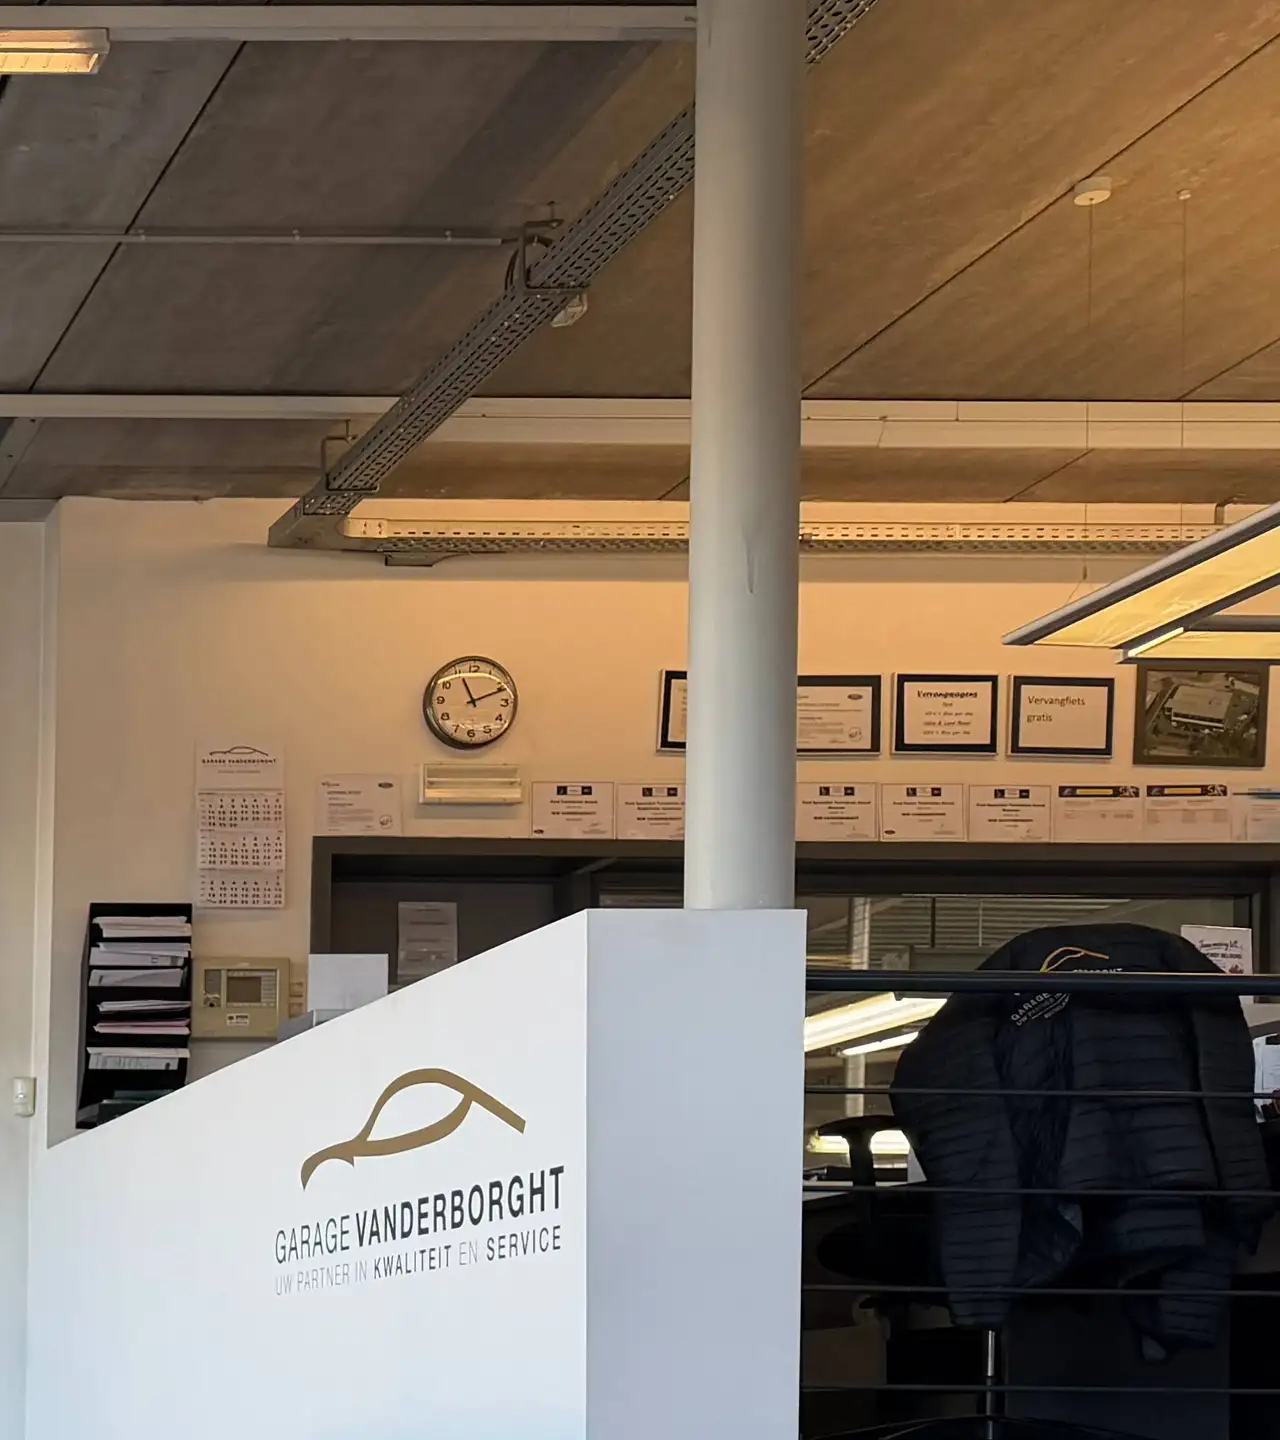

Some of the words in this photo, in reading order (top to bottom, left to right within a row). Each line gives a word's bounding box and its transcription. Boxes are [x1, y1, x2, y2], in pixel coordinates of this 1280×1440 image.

[442, 680, 451, 690] 10
[436, 695, 445, 705] 9
[500, 698, 509, 708] 3
[1027, 695, 1086, 707] Vervangfiets
[441, 712, 450, 720] 8
[495, 713, 503, 722] 4
[1026, 713, 1052, 724] gratis
[452, 723, 459, 733] 7
[483, 725, 492, 734] 5
[466, 729, 476, 738] 6
[274, 1213, 351, 1265] GARAGE
[355, 1164, 566, 1248] VANDERBORGHT
[274, 1274, 293, 1296] UW
[297, 1263, 351, 1293] PARTNER
[355, 1260, 368, 1283] IN
[373, 1244, 452, 1280] KWALITEIT
[458, 1240, 478, 1267] EN
[486, 1224, 562, 1262] SERVICE
